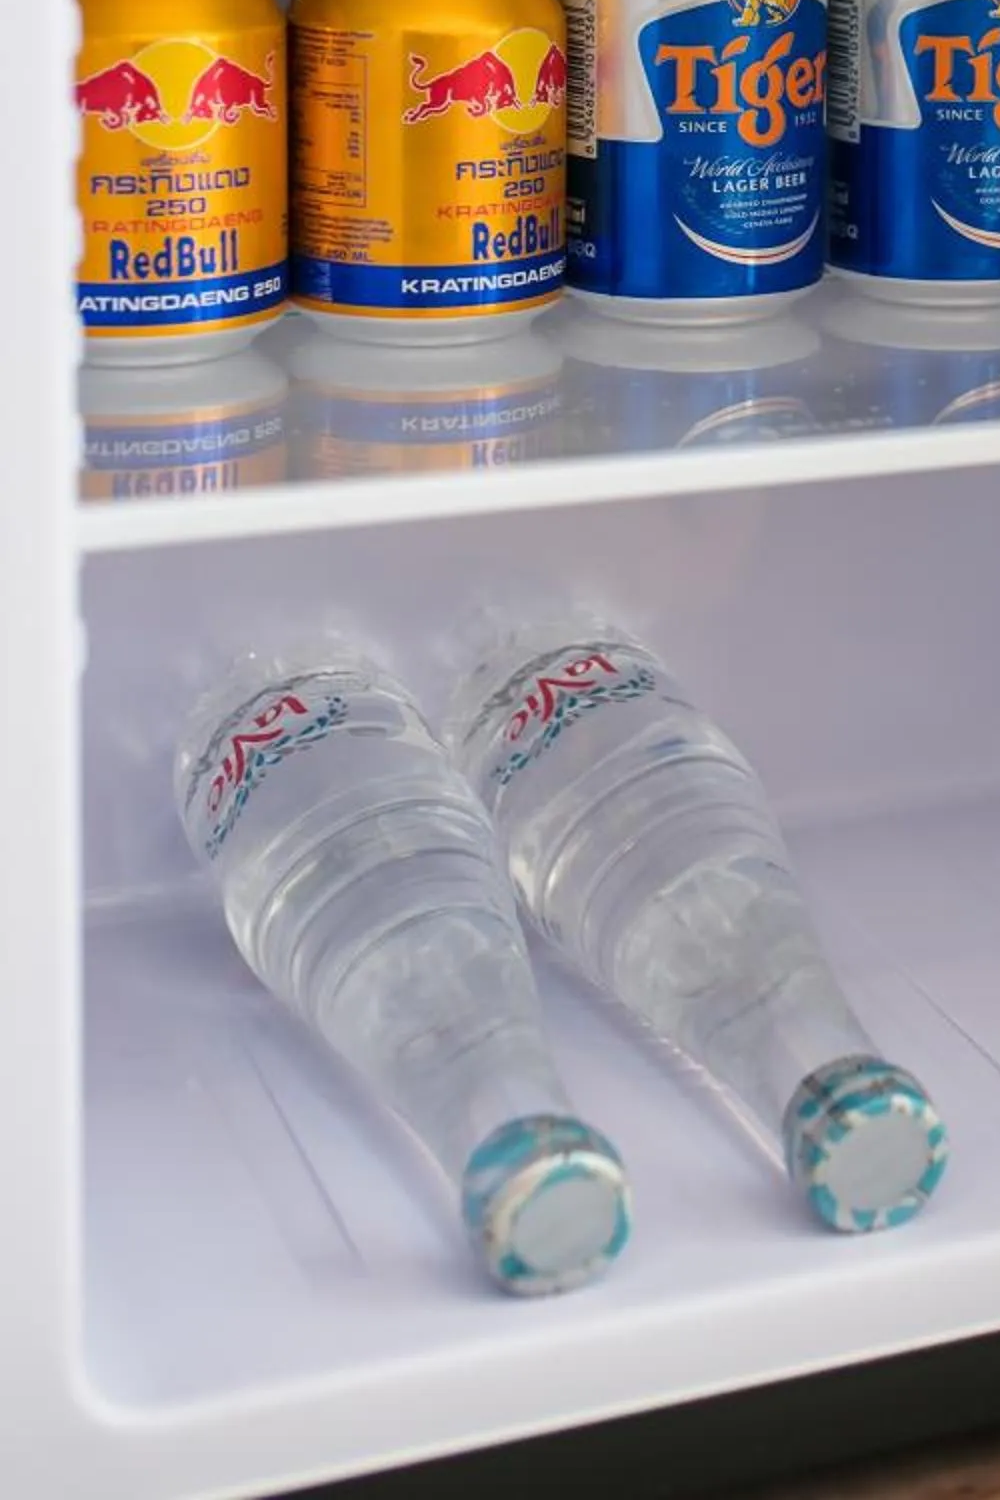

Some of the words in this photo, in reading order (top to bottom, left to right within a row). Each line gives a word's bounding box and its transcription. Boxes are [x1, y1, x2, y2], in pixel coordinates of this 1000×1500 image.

[655, 31, 827, 148] Tiger
[936, 108, 984, 121] SINCE
[679, 121, 728, 133] SINCE
[504, 177, 546, 198] 250
[713, 177, 770, 193] LAGER
[775, 172, 807, 189] BEER
[146, 197, 207, 217] 250
[92, 208, 264, 235] RATINGDAENG
[472, 205, 561, 261] RedBull
[108, 227, 239, 280] RedBull
[79, 286, 249, 312] ATINGDAENG
[254, 276, 281, 297] 250
